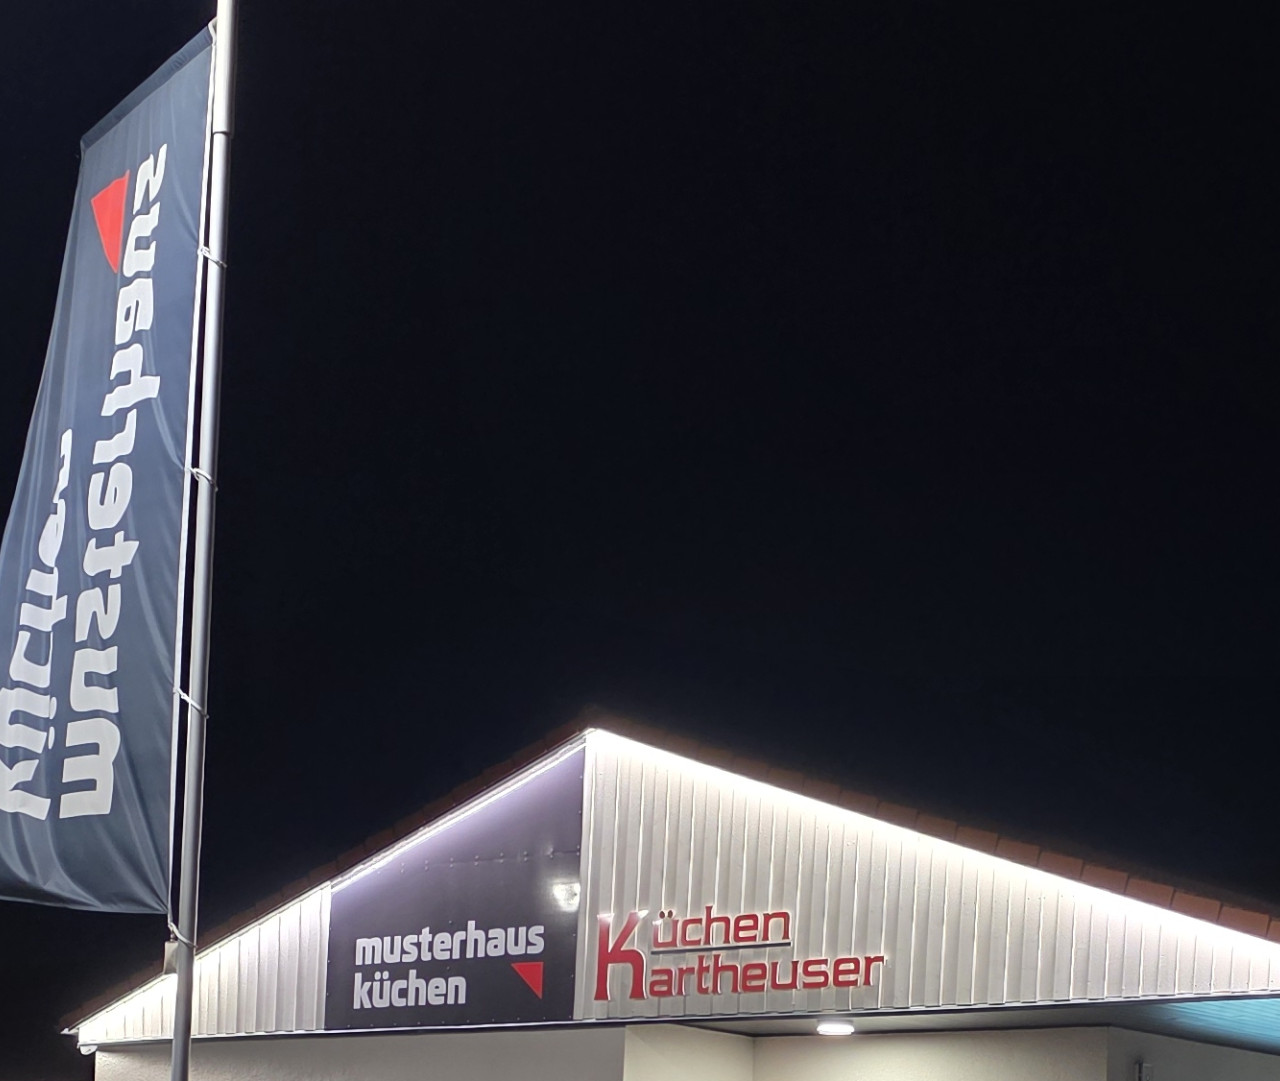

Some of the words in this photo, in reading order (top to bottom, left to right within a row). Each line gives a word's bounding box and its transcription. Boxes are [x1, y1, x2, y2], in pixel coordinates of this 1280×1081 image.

[355, 920, 545, 966] musterhaus
[593, 905, 791, 1001] Küchen
[353, 969, 467, 1010] küchen
